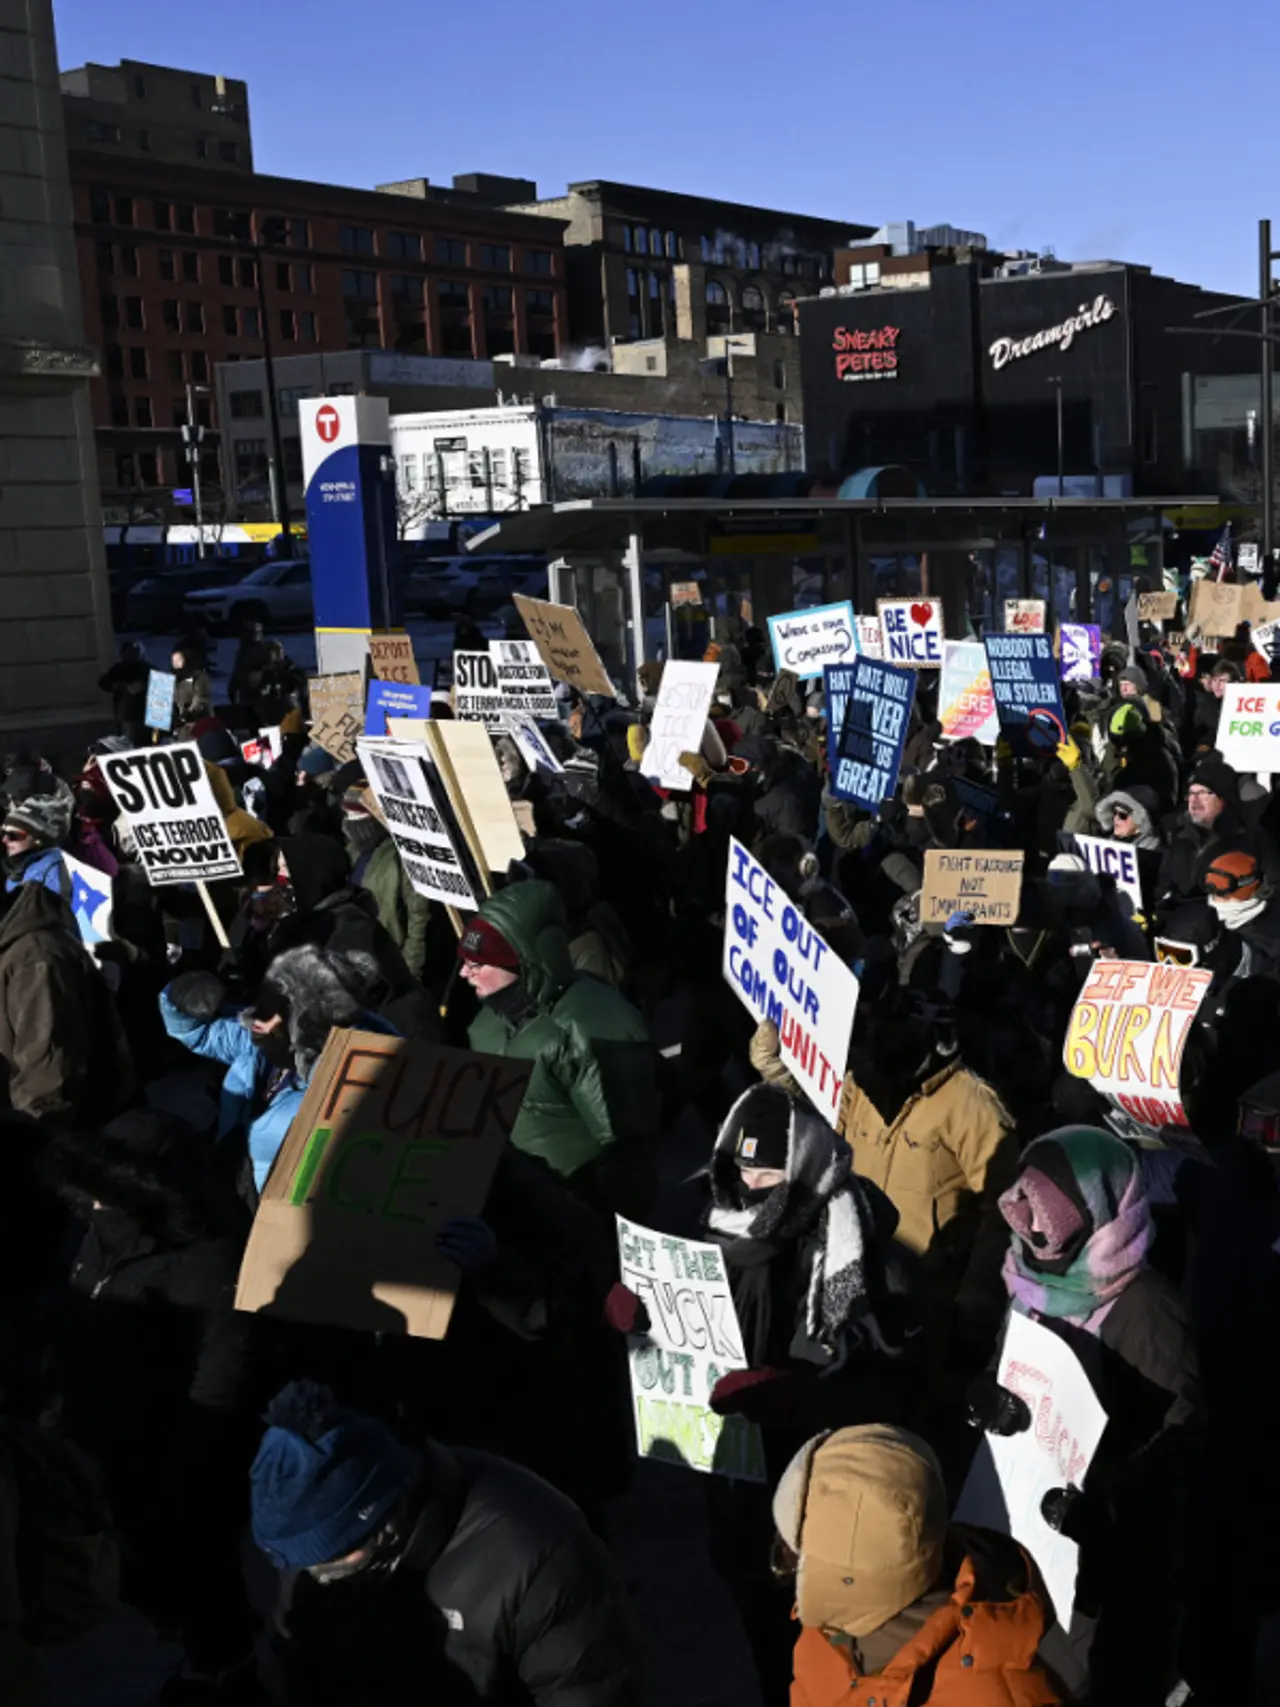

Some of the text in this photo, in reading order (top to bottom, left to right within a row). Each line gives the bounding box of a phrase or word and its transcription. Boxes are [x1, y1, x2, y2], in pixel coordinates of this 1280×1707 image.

[832, 326, 900, 350] SNEAKY
[988, 294, 1119, 370] Dreamgirls
[885, 608, 907, 632] BE
[888, 631, 941, 661] NICE
[986, 637, 1034, 658] NOBODY
[1035, 637, 1050, 658] IS
[829, 671, 853, 691] HAT
[855, 663, 909, 701] HATE WILL
[990, 660, 1034, 681] ILLEGAL
[501, 685, 552, 695] RENEE
[994, 681, 1058, 704] ON STOLEN
[1236, 697, 1266, 713] ICE
[1229, 720, 1263, 737] FOR
[106, 748, 202, 814] STOP
[836, 760, 891, 805] GREAT
[132, 815, 225, 848] ICE TERROR
[143, 842, 232, 866] NOW!
[938, 855, 973, 872] FIGHT
[959, 877, 984, 892] NOT
[730, 845, 828, 972] ICE OUT
[929, 896, 1013, 919] IMMIGRANTS
[731, 902, 821, 1026] OF OUR
[1082, 961, 1214, 1010] IF WE
[728, 945, 843, 1109] COMMUNITY
[1066, 1000, 1196, 1090] BURN
[322, 1046, 530, 1141] FUCK
[660, 1237, 724, 1283] THE
[623, 1266, 743, 1361] FUCK
[634, 1344, 695, 1397] OUT
